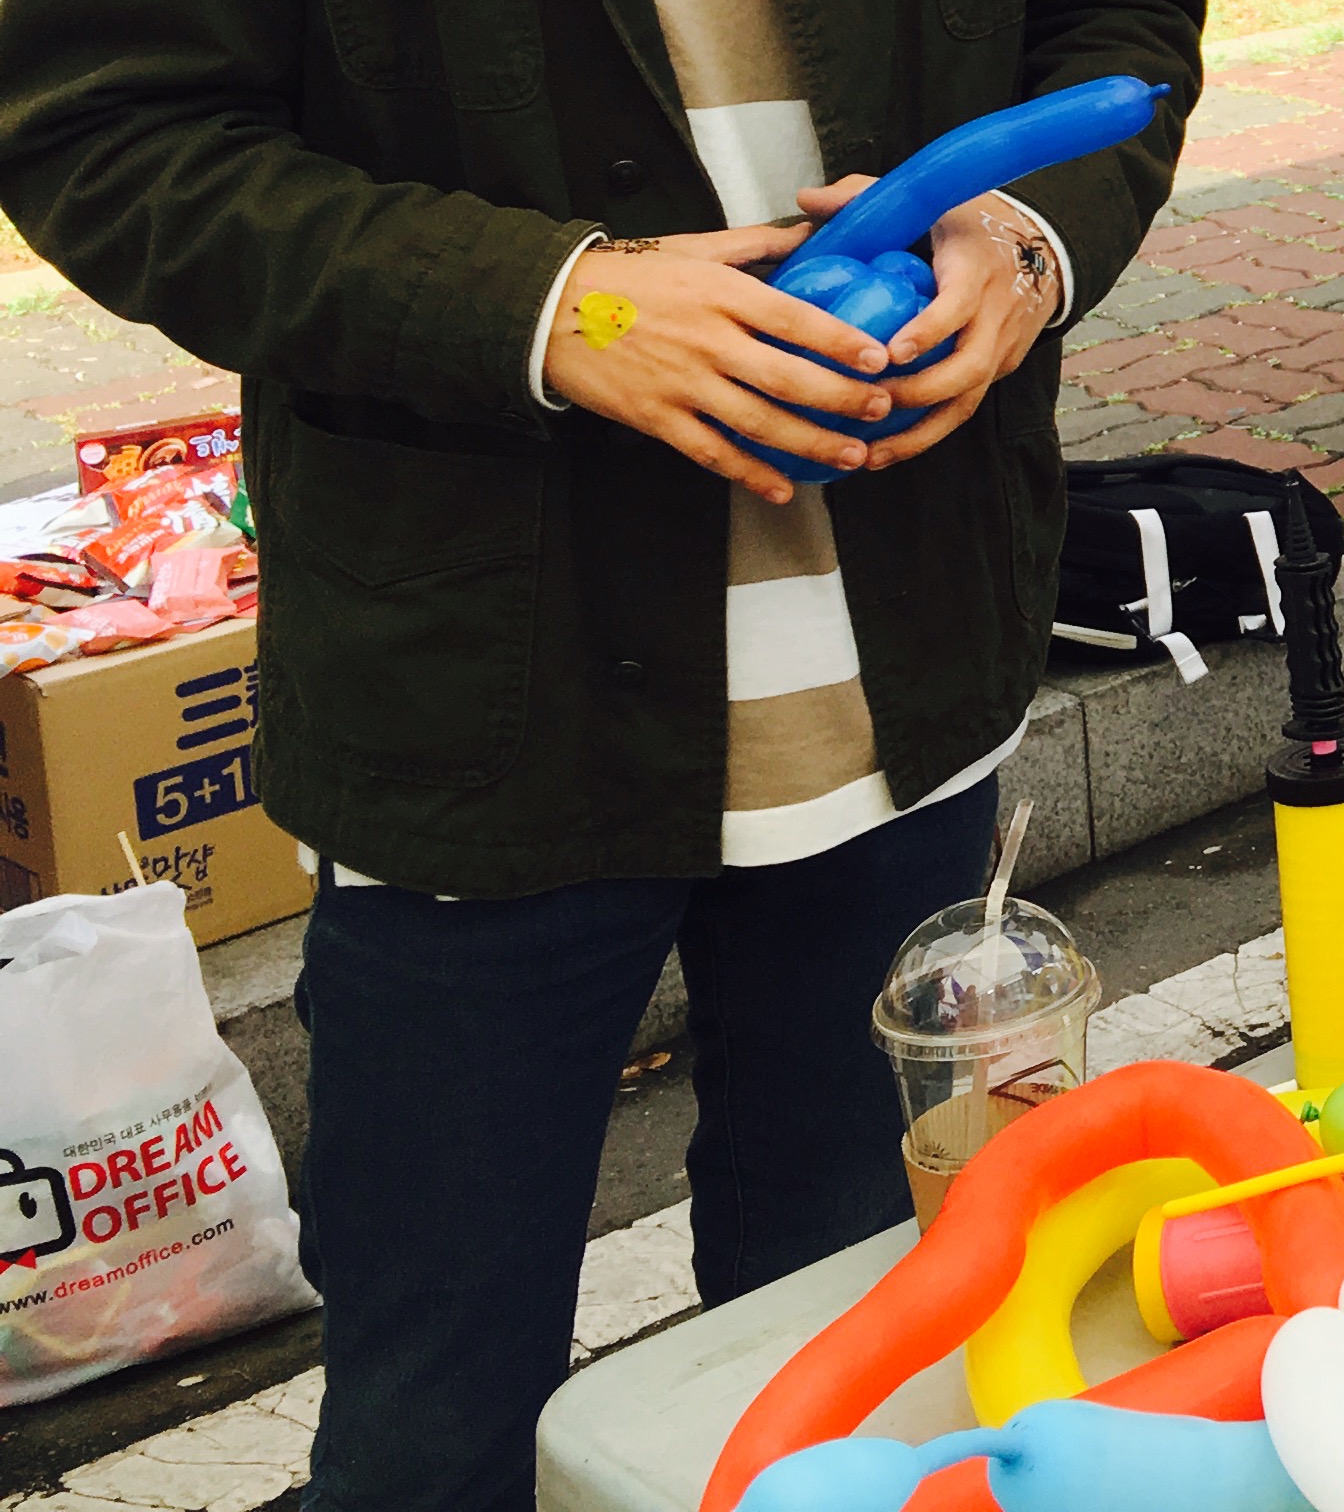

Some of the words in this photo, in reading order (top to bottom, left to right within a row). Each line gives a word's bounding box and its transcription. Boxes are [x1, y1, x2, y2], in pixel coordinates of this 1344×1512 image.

[155, 756, 246, 827] 5+1
[62, 1131, 117, 1158] 대한민국
[119, 1120, 147, 1141] 대표
[68, 1099, 224, 1202] DREAM
[82, 1142, 248, 1245] OFFICE
